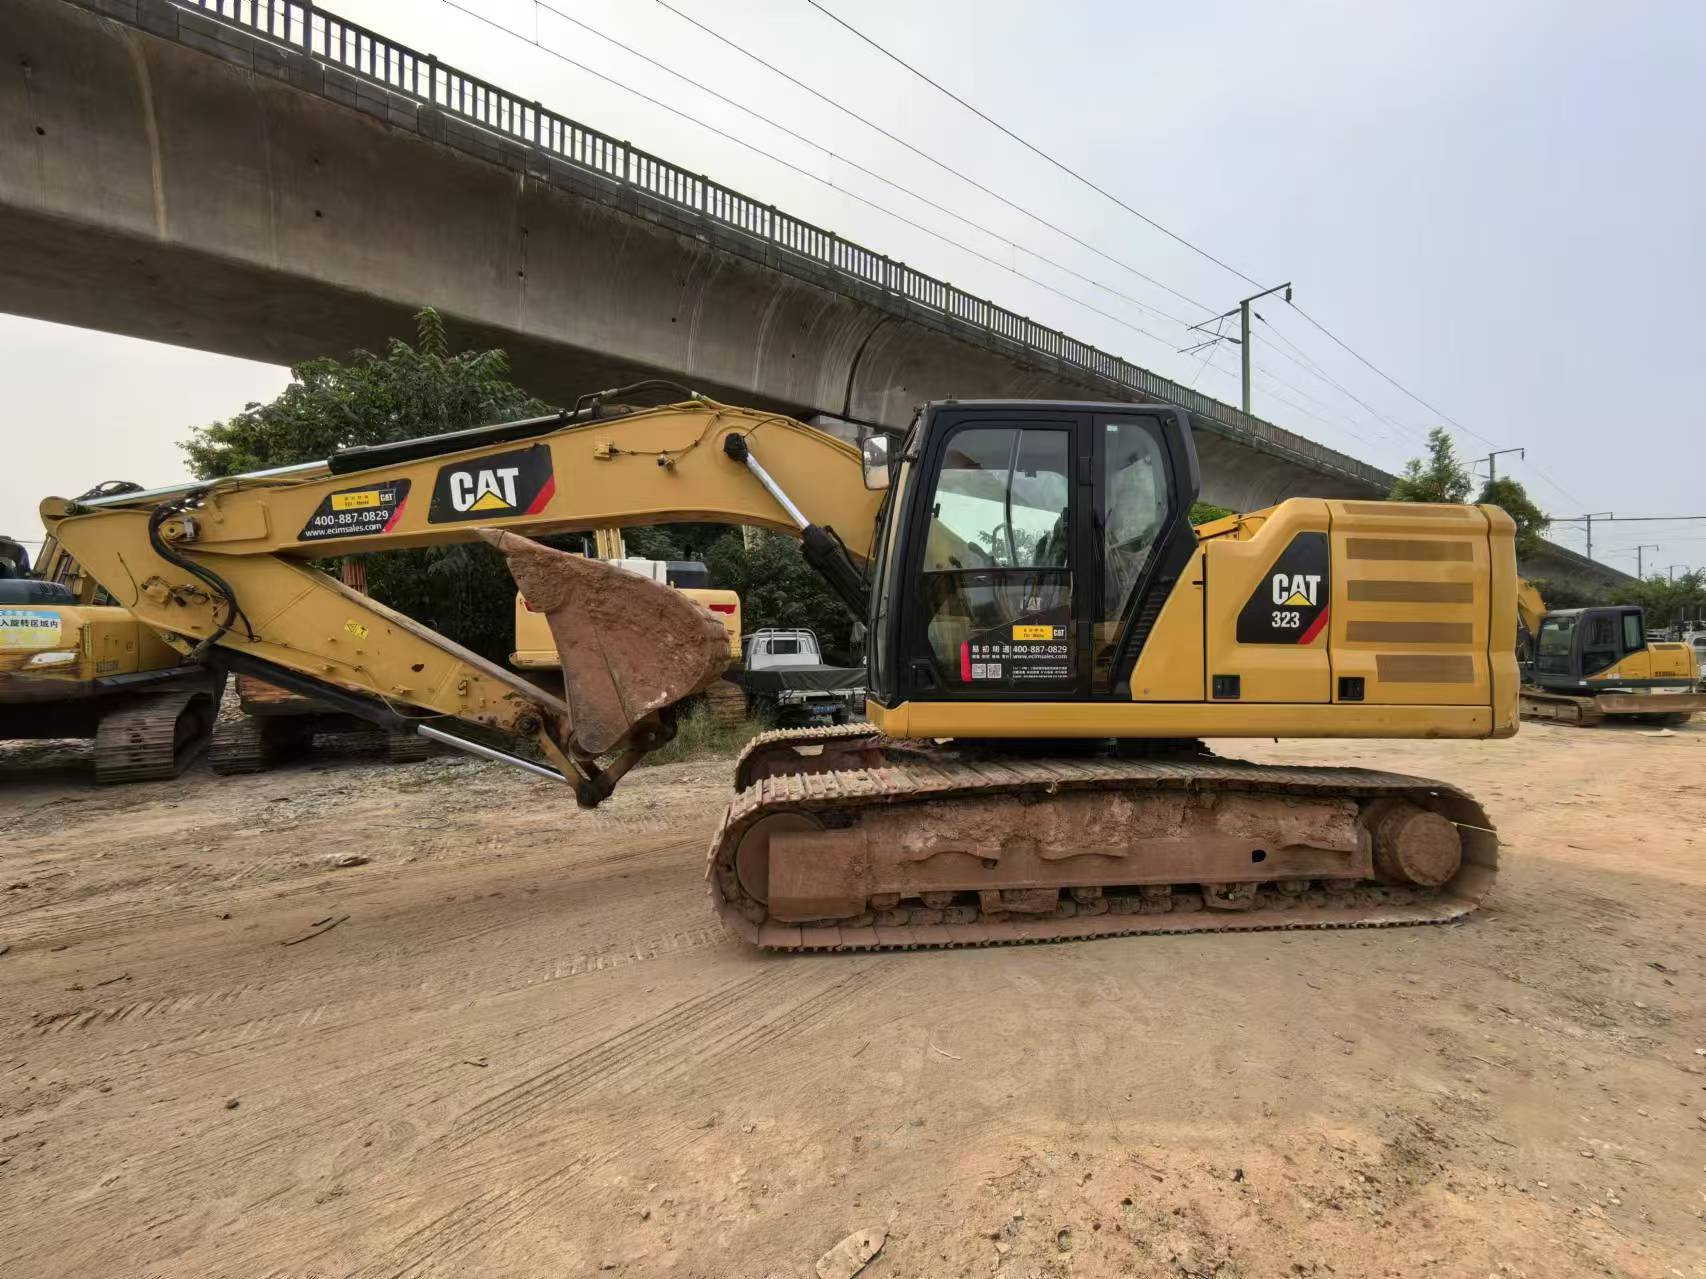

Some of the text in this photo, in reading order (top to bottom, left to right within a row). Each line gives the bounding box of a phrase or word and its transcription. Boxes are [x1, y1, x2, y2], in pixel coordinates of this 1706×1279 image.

[450, 467, 519, 511] CAT
[380, 493, 393, 501] CAT
[314, 510, 389, 526] 400-887-0829
[305, 523, 382, 537] www.ecimsales.com
[1272, 573, 1321, 606] CAT
[1271, 610, 1300, 628] 323
[1053, 629, 1064, 637] CAT
[1012, 645, 1068, 654] 400-887-0829
